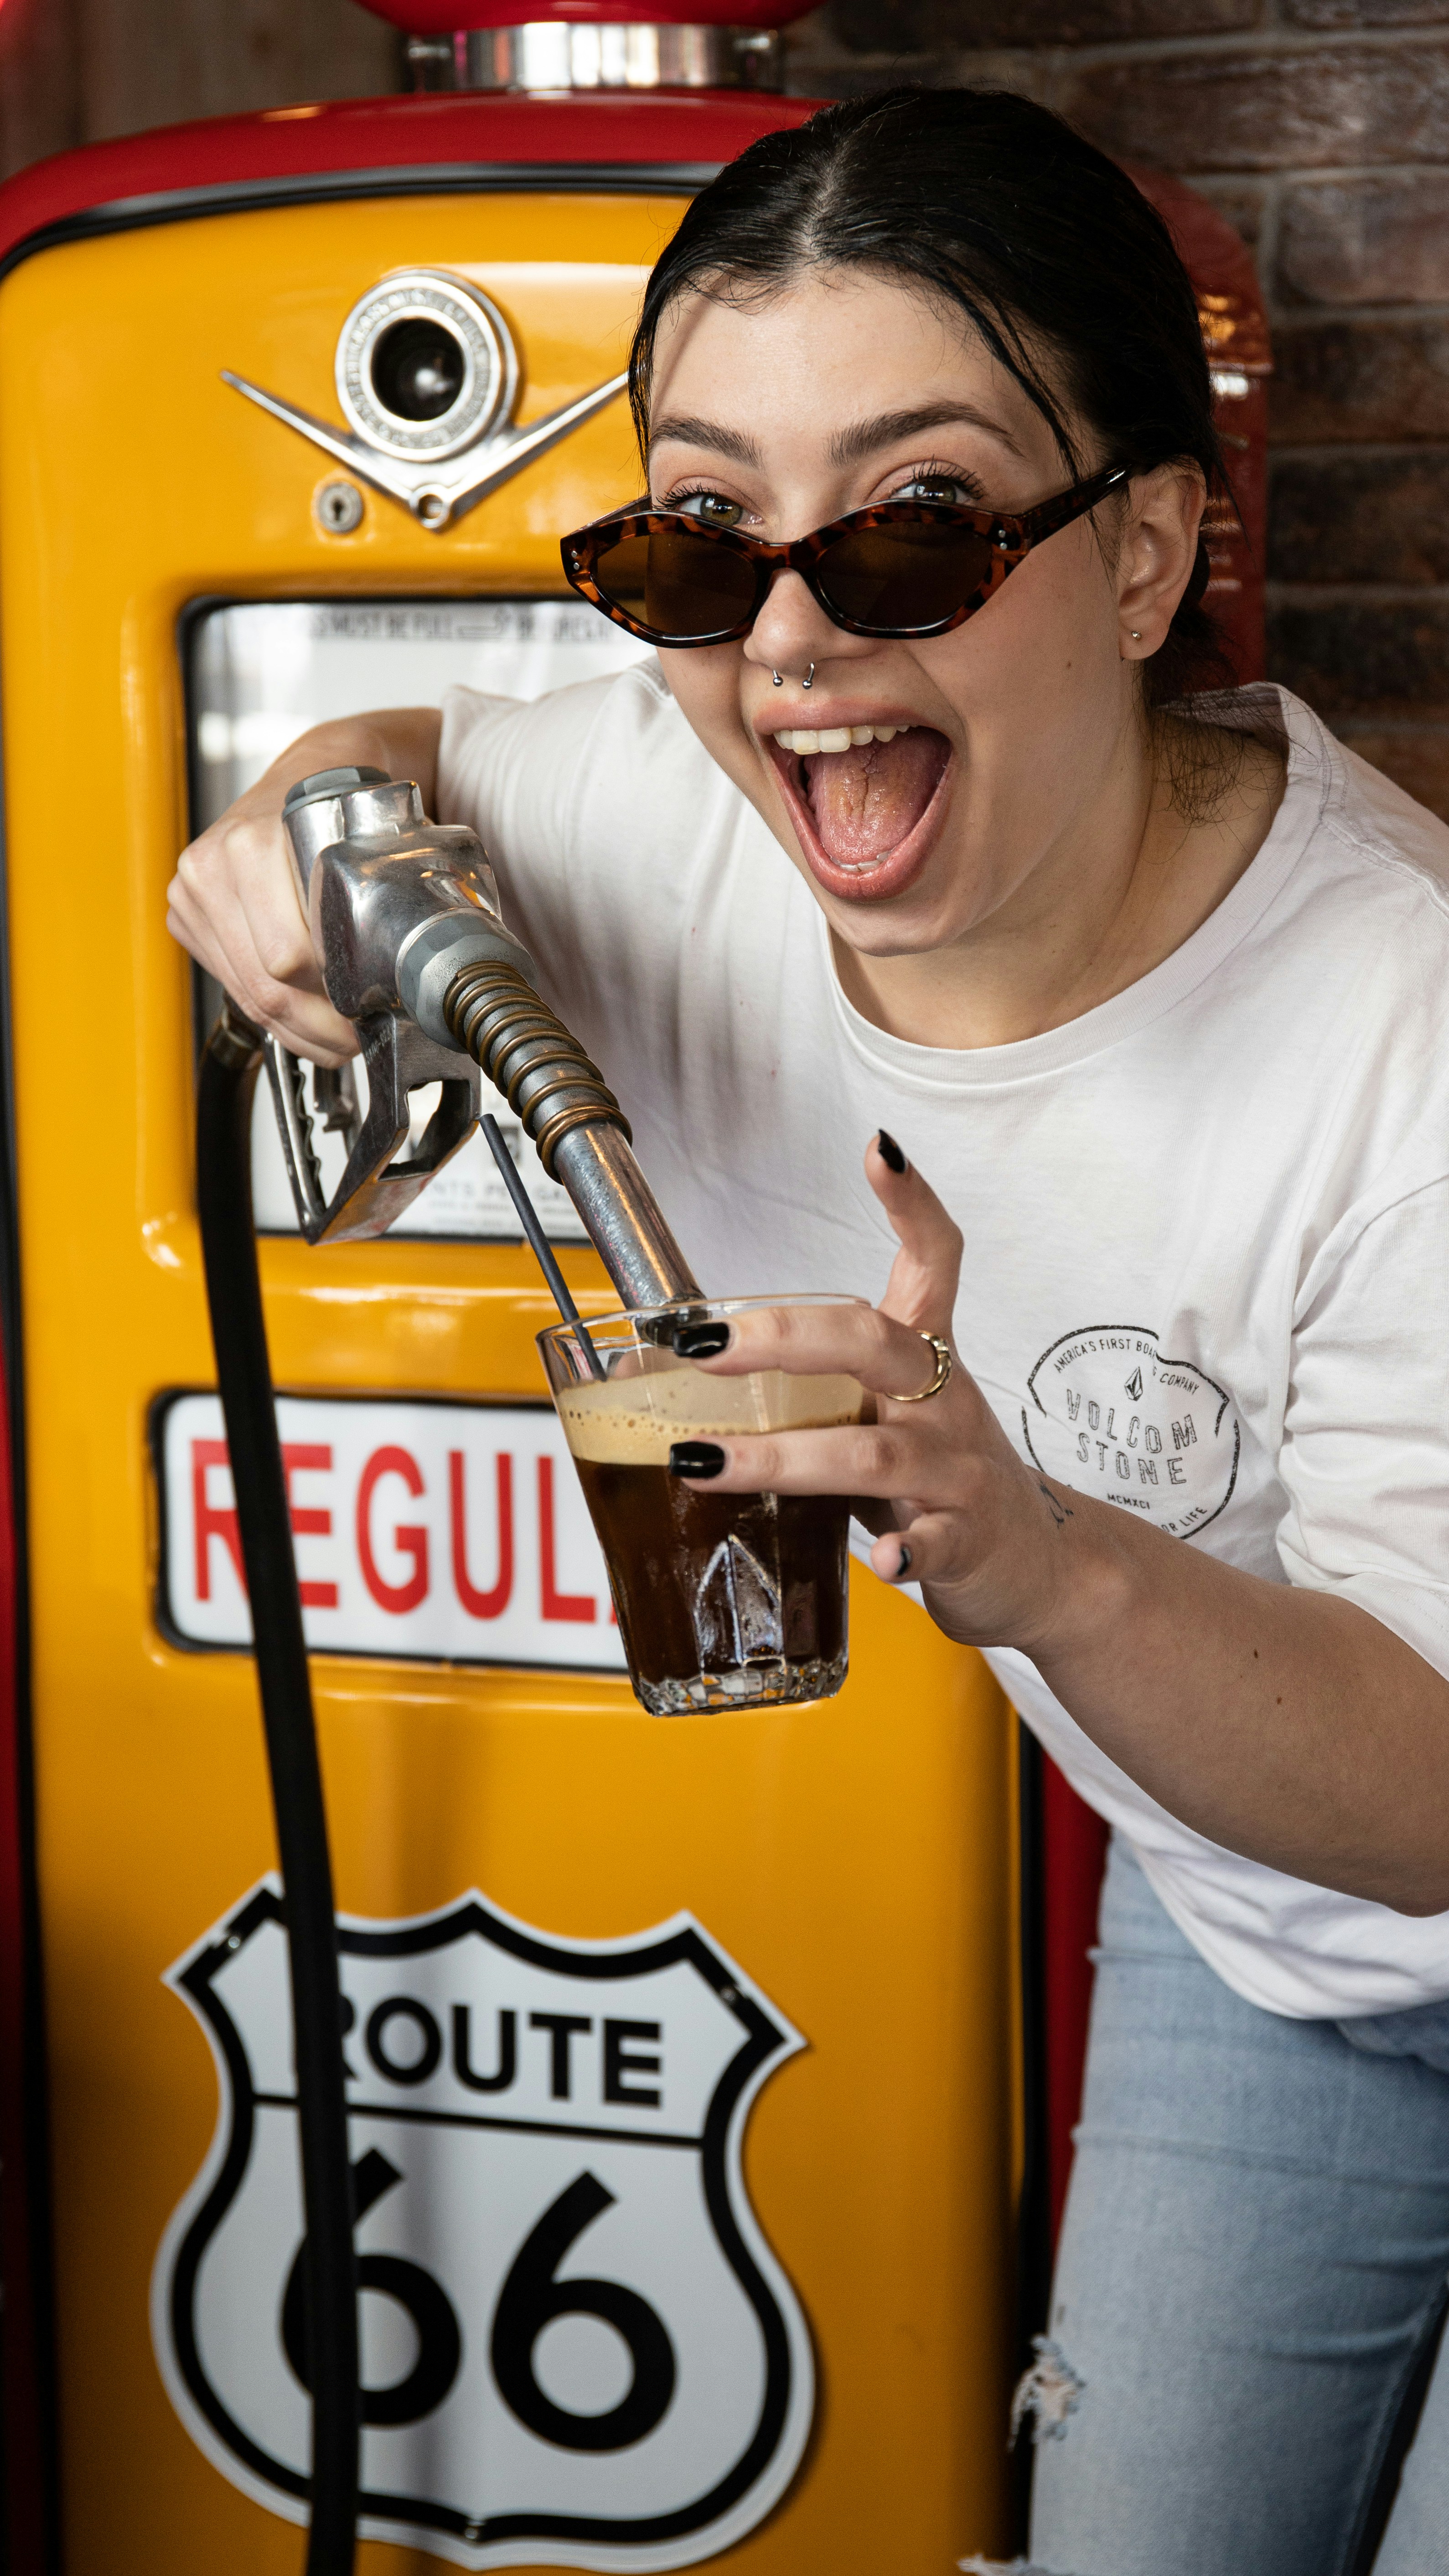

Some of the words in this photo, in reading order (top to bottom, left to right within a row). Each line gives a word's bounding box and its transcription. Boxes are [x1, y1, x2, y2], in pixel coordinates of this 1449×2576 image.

[1053, 1340, 1097, 1373] AMERICA'S
[1099, 1338, 1131, 1350] FIRST
[1159, 1373, 1199, 1395] COMPANY
[1066, 1389, 1198, 1454] VOLCOM
[1076, 1433, 1187, 1485] STONE
[1107, 1493, 1150, 1510] MCMXCI
[1161, 1522, 1178, 1532] OR
[1179, 1506, 1208, 1527] LIFE
[191, 1438, 620, 1626] REGUL
[280, 2147, 680, 2453] 66
